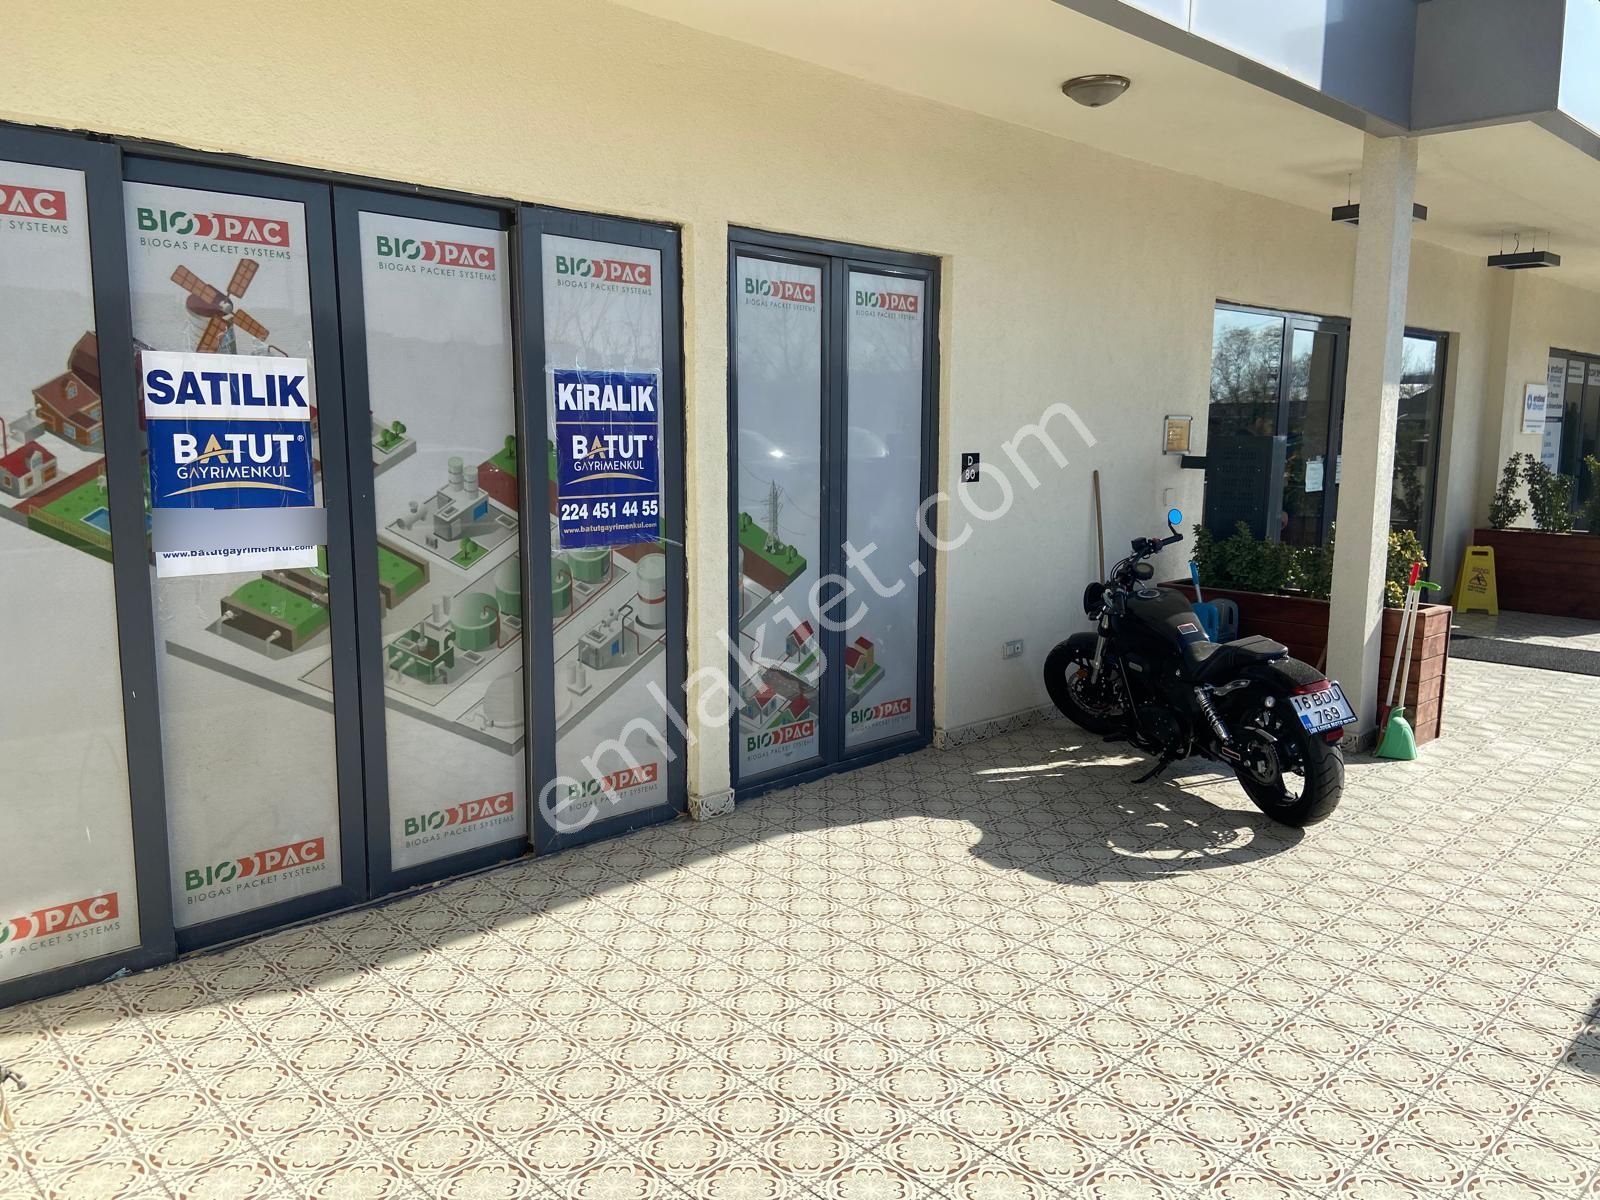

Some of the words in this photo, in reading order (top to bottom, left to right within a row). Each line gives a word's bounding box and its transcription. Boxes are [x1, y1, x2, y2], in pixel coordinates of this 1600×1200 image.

[9, 219, 69, 235] SYSTEMS
[140, 237, 188, 250] BIOGAS
[194, 243, 239, 255] PACKET
[244, 247, 291, 260] SYSTEMS
[378, 262, 416, 273] BIOGAS
[421, 266, 455, 277] PACKET
[460, 271, 497, 281] SYSTEMS
[557, 279, 588, 289] BIOGAS
[591, 282, 619, 292] PACKET
[622, 286, 652, 296] SYSTEMS
[146, 369, 308, 408] SATILIK
[173, 432, 295, 465] BATUT
[572, 434, 648, 460] BATUT
[967, 455, 974, 467] D
[561, 503, 589, 521] 224
[592, 502, 617, 519] 451
[622, 501, 639, 517] 44
[642, 500, 659, 516] 55
[563, 521, 657, 534] www.batutgayrimenkul.com
[1294, 696, 1312, 711] 16
[1311, 688, 1341, 707] BDU
[1314, 706, 1341, 724] 769
[630, 784, 658, 797] SYSTEMS
[405, 834, 441, 849] BIOGAS
[444, 824, 476, 838] PACKET
[480, 815, 514, 829] SYSTEMS
[187, 887, 232, 905] BIOGAS
[236, 874, 278, 892] PACKET
[282, 863, 326, 880] SYSTEMS
[10, 936, 61, 956] PACKET
[67, 921, 121, 942] SYSTEMS
